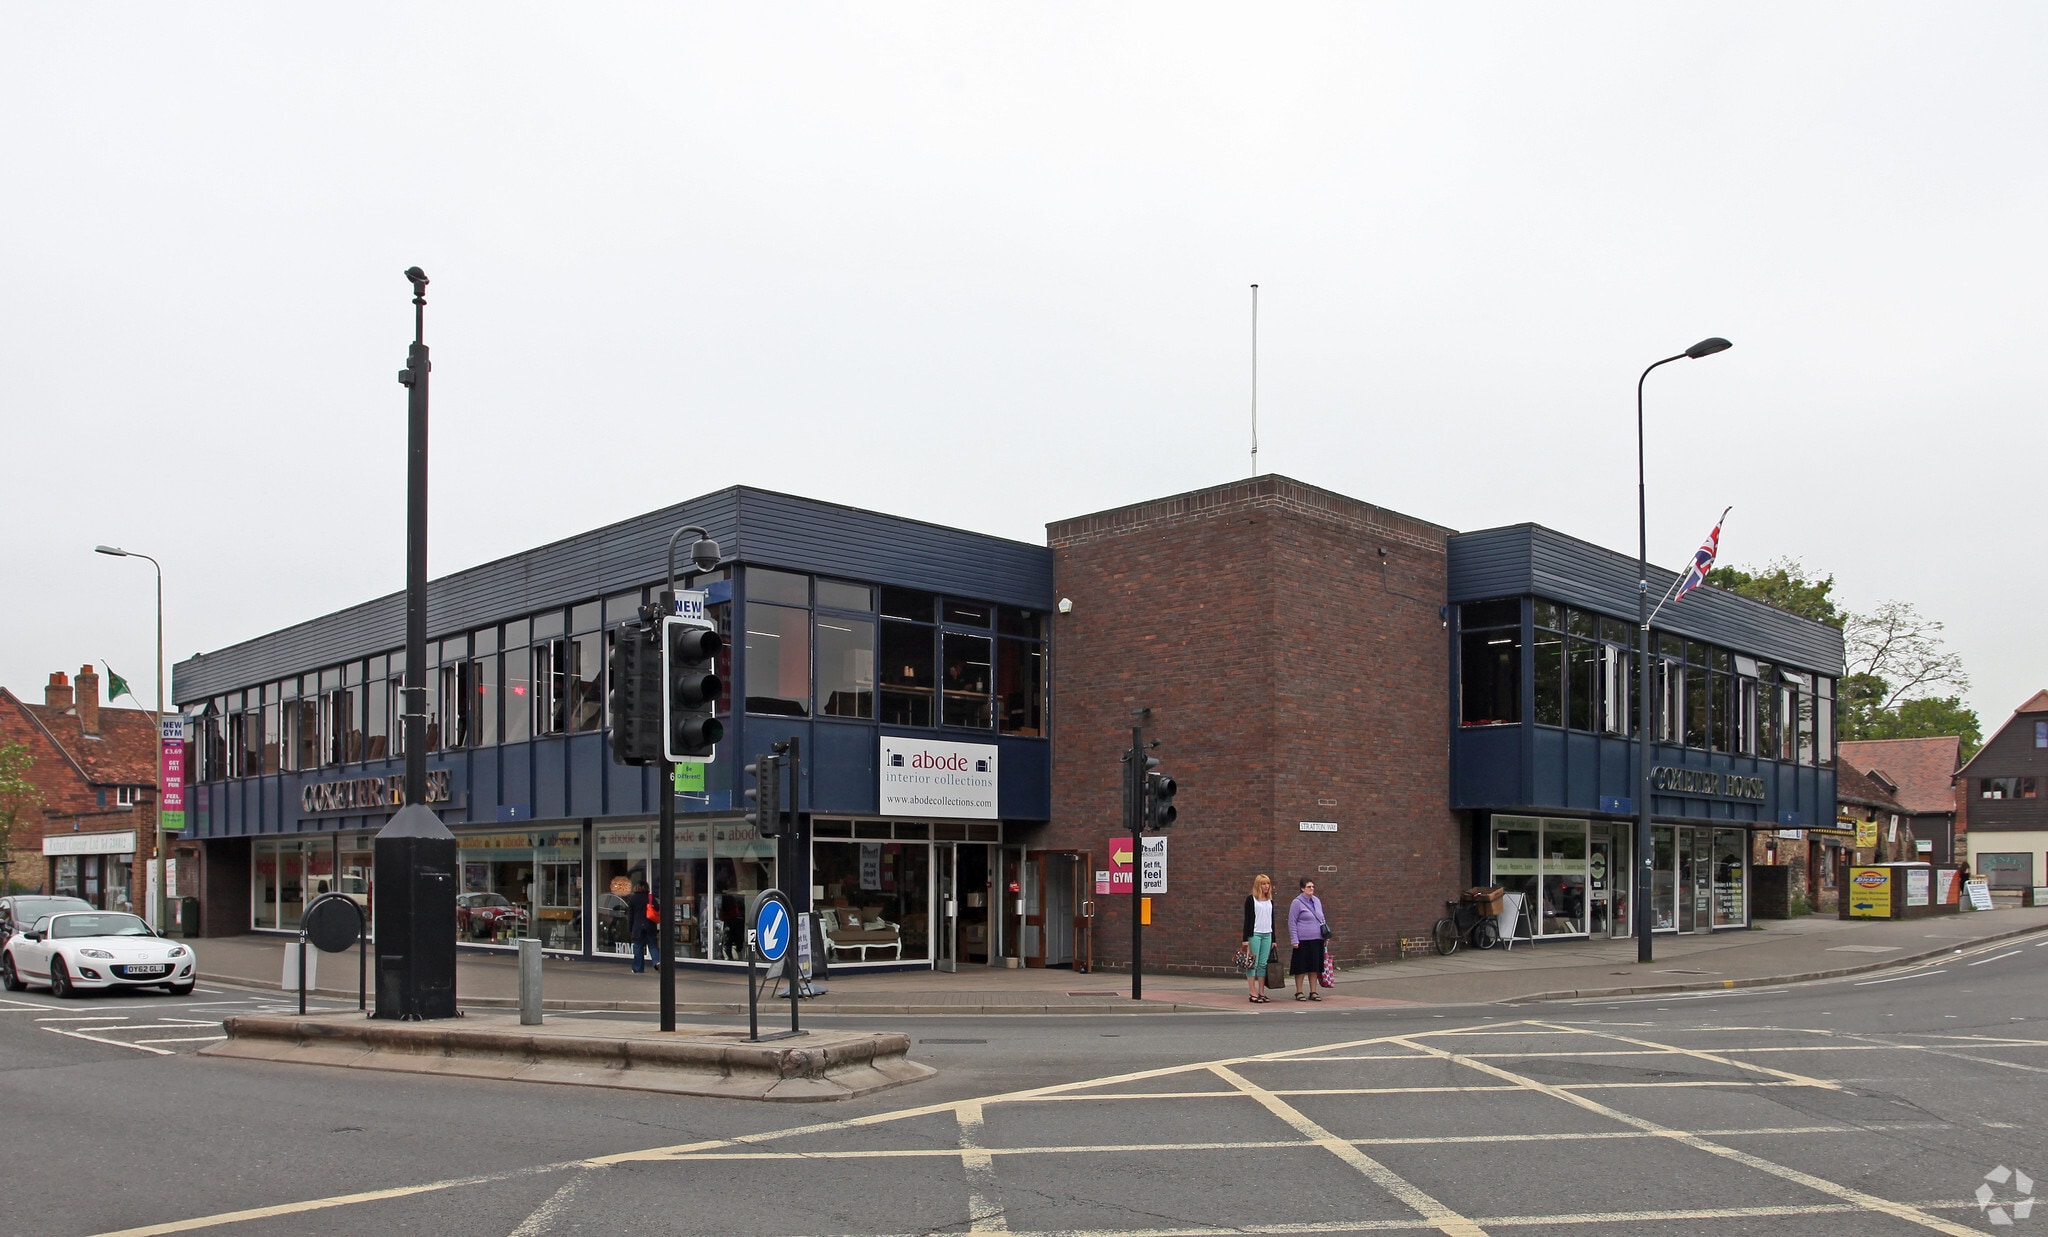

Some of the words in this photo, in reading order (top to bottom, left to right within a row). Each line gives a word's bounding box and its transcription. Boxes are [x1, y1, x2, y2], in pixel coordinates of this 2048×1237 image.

[675, 601, 701, 612] NEW
[163, 721, 182, 729] NEW
[163, 729, 182, 737] GYM
[912, 750, 968, 772] abode
[669, 772, 675, 781] 6
[886, 771, 930, 784] interior
[934, 773, 992, 787] collections
[1650, 765, 1719, 795] COXETER
[1722, 773, 1764, 800] HOUSE
[302, 777, 385, 812] COXETER
[887, 795, 992, 808] www.abodecollections.com
[1154, 861, 1162, 869] fit,
[1113, 872, 1133, 884] GYM
[1144, 870, 1162, 879] feel
[1855, 876, 1886, 884] Dickies
[1144, 880, 1162, 889] great!
[615, 942, 634, 955] HOM
